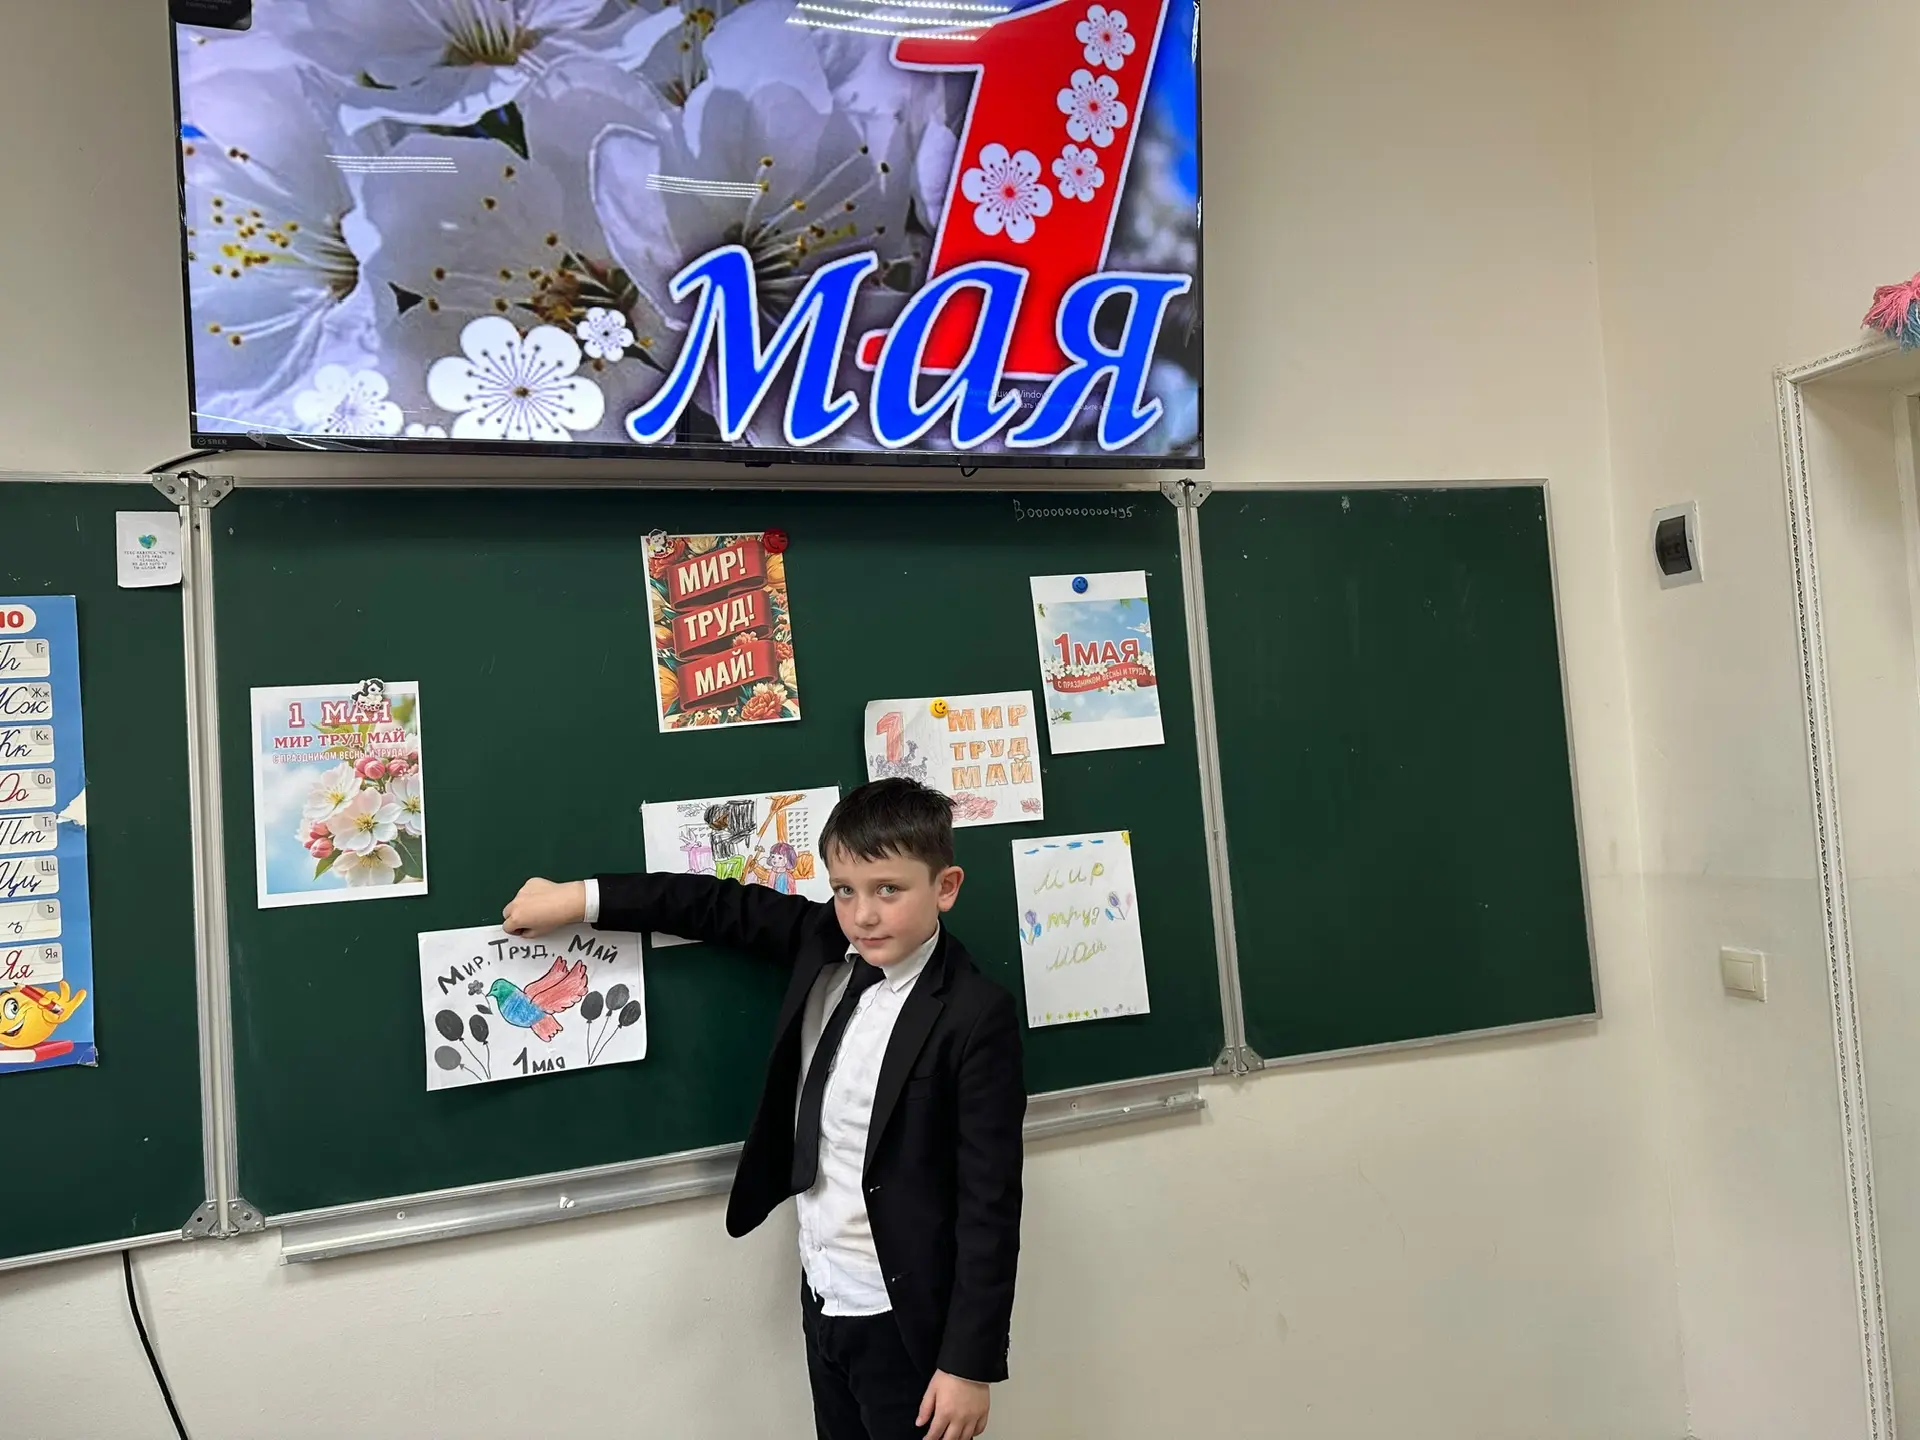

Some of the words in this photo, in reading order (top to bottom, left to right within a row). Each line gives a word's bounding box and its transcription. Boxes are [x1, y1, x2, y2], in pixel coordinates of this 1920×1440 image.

[858, 0, 1168, 377] 1
[678, 547, 746, 596] МИР!
[684, 595, 755, 642] ТРУД!
[695, 649, 755, 697] МАЙ!
[288, 700, 305, 729] 1
[274, 735, 314, 750] МИР
[317, 732, 363, 748] ТРУД
[367, 728, 406, 745] МАЙ
[876, 711, 905, 763] 1
[946, 704, 1028, 732] МИР
[949, 736, 1031, 761] ТРУД
[280, 751, 338, 763] ПРАЗДНИКОМ
[951, 758, 1034, 790] МАЙ
[512, 1046, 529, 1075] 1
